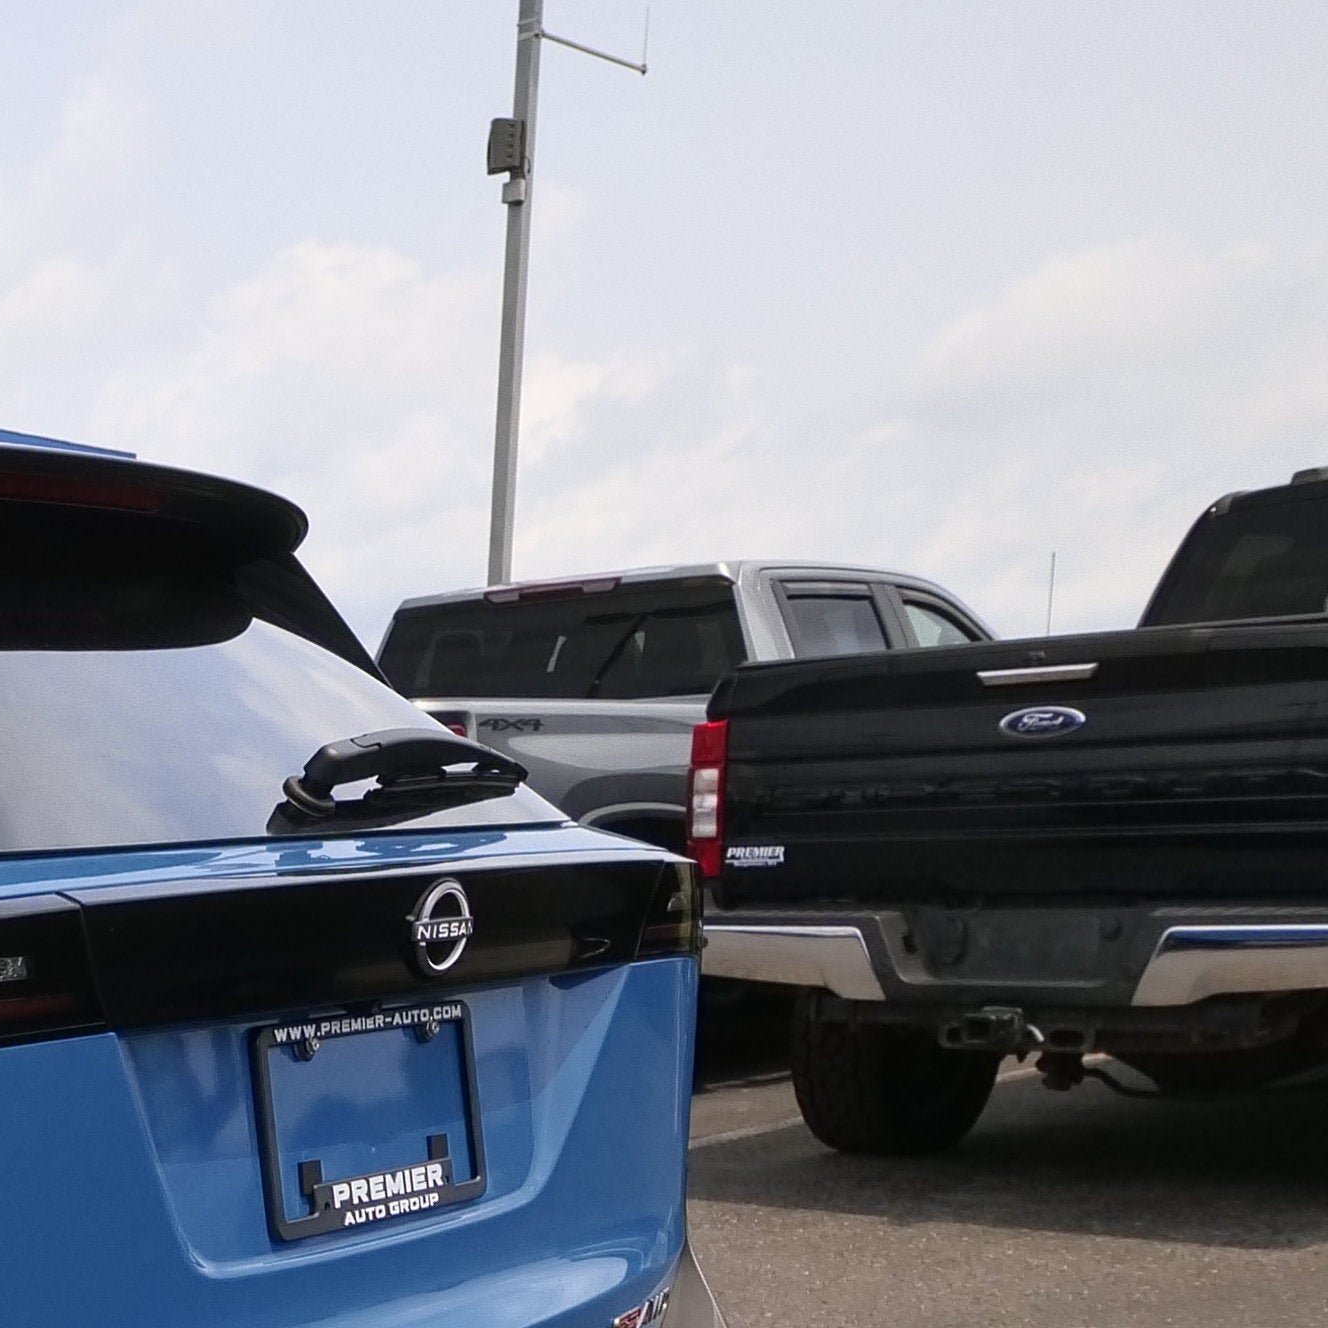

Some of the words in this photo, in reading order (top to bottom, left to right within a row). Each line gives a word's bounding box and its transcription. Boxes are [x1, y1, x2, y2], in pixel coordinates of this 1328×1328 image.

[726, 846, 785, 859] PREMIER
[417, 920, 473, 940] NISSAN
[274, 1004, 462, 1043] WWW.PREMIER-AUTO.COM
[332, 1163, 444, 1209] PREMIER
[344, 1204, 386, 1226] AUTO
[389, 1192, 440, 1217] GROUP
